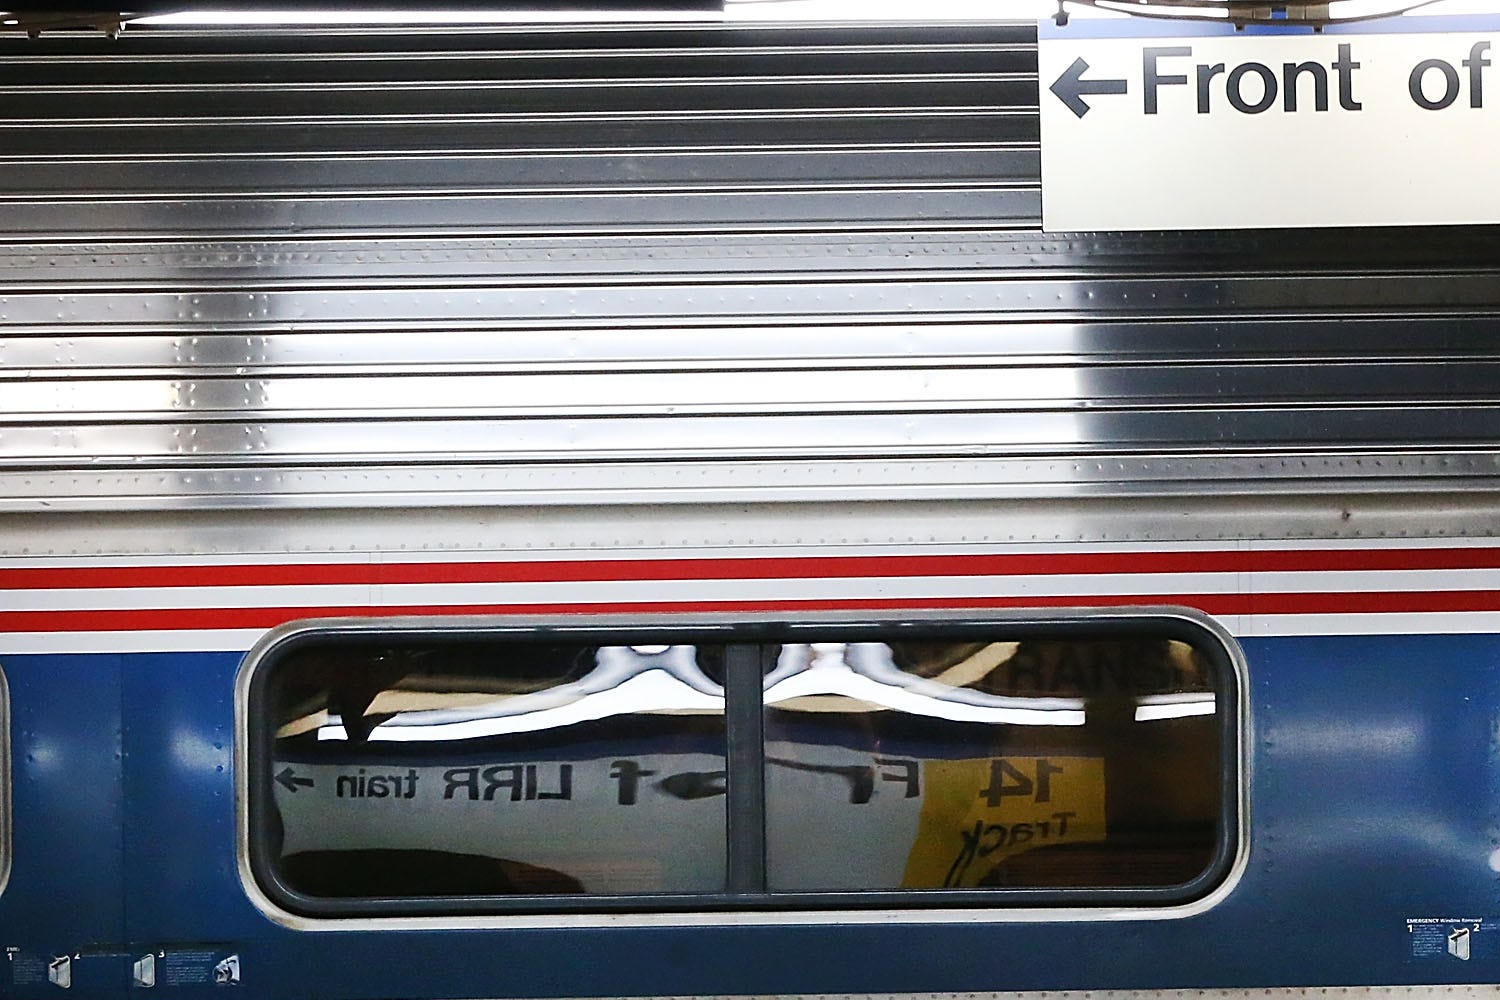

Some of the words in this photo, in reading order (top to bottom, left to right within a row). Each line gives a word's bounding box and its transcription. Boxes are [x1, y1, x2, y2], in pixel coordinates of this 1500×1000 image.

[1142, 42, 1363, 115] Front
[1408, 41, 1491, 111] of
[1407, 924, 1413, 933] 1
[1473, 923, 1480, 932] 2
